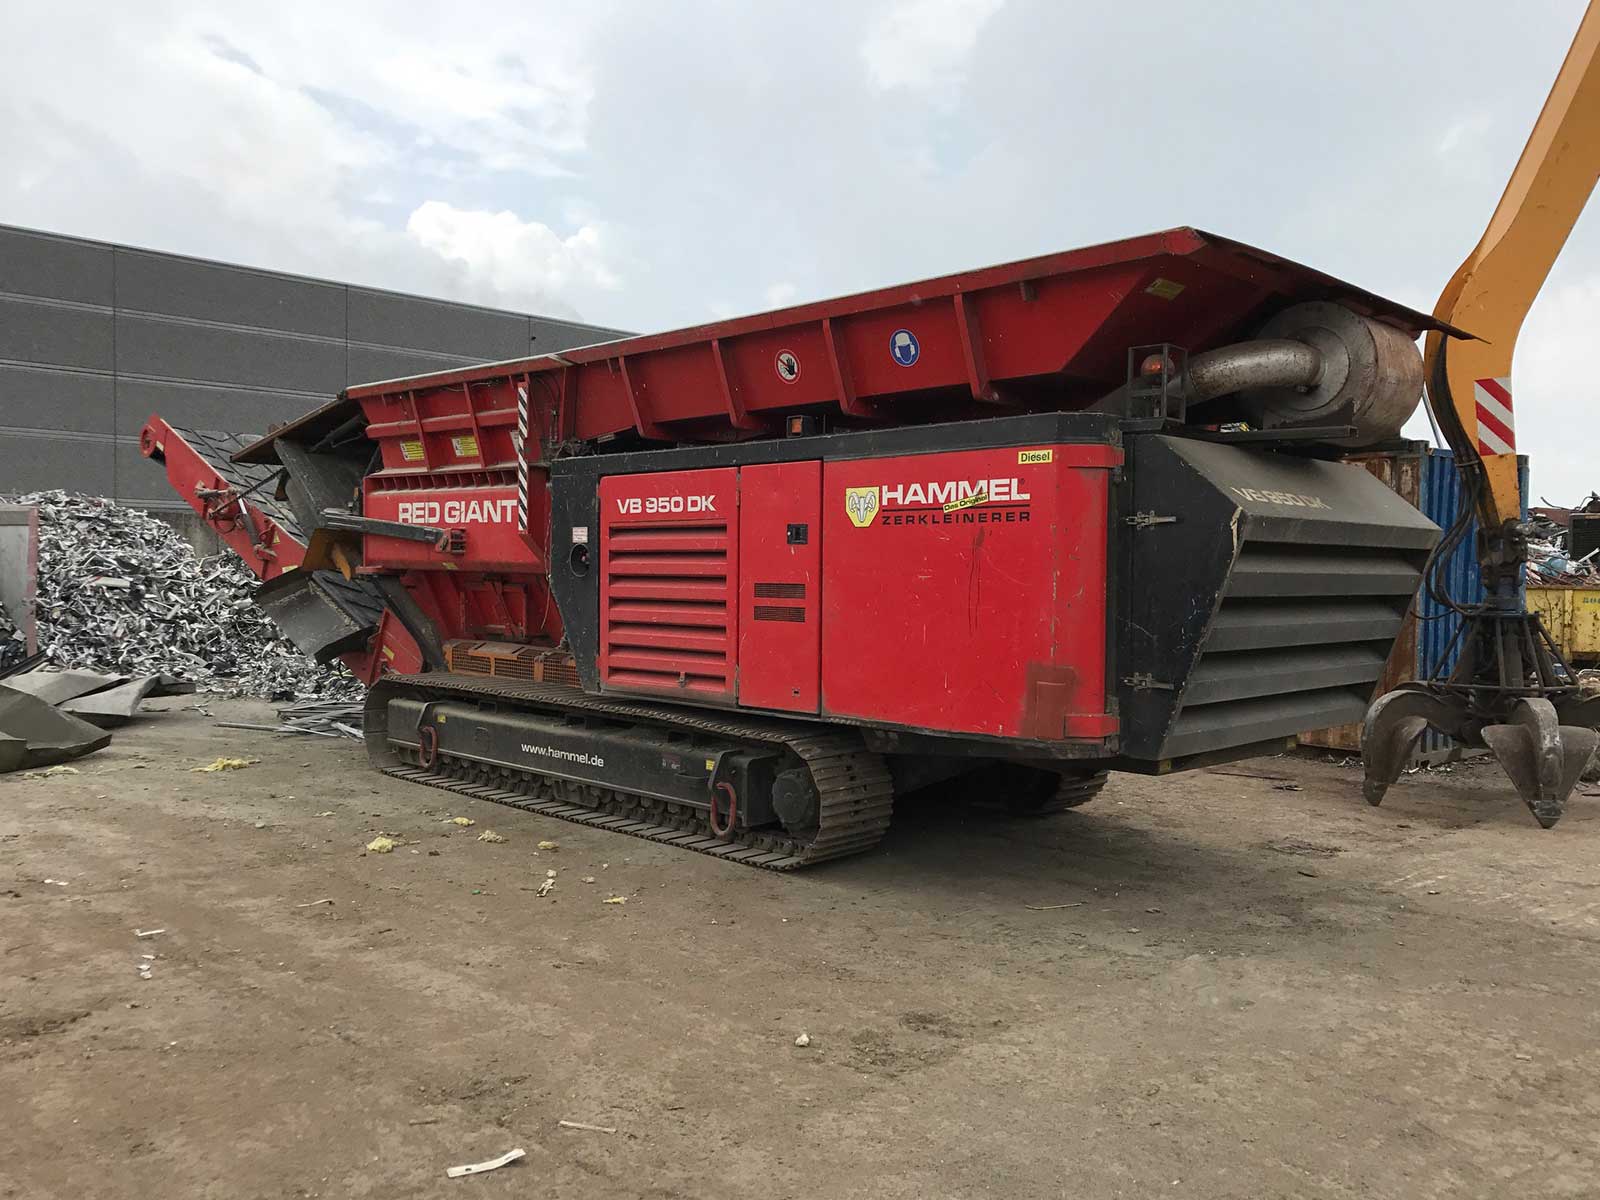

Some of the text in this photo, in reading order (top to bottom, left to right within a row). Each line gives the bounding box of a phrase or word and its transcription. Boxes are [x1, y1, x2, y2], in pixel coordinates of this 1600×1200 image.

[1020, 452, 1050, 462] Diesel
[881, 478, 1031, 506] HAMMEL
[398, 499, 518, 524] RED GIANT
[616, 494, 717, 514] VB 950 DK
[943, 494, 988, 512] Das Original
[881, 511, 1031, 526] ZERKLEINERER
[520, 743, 604, 768] www.hammel.de
